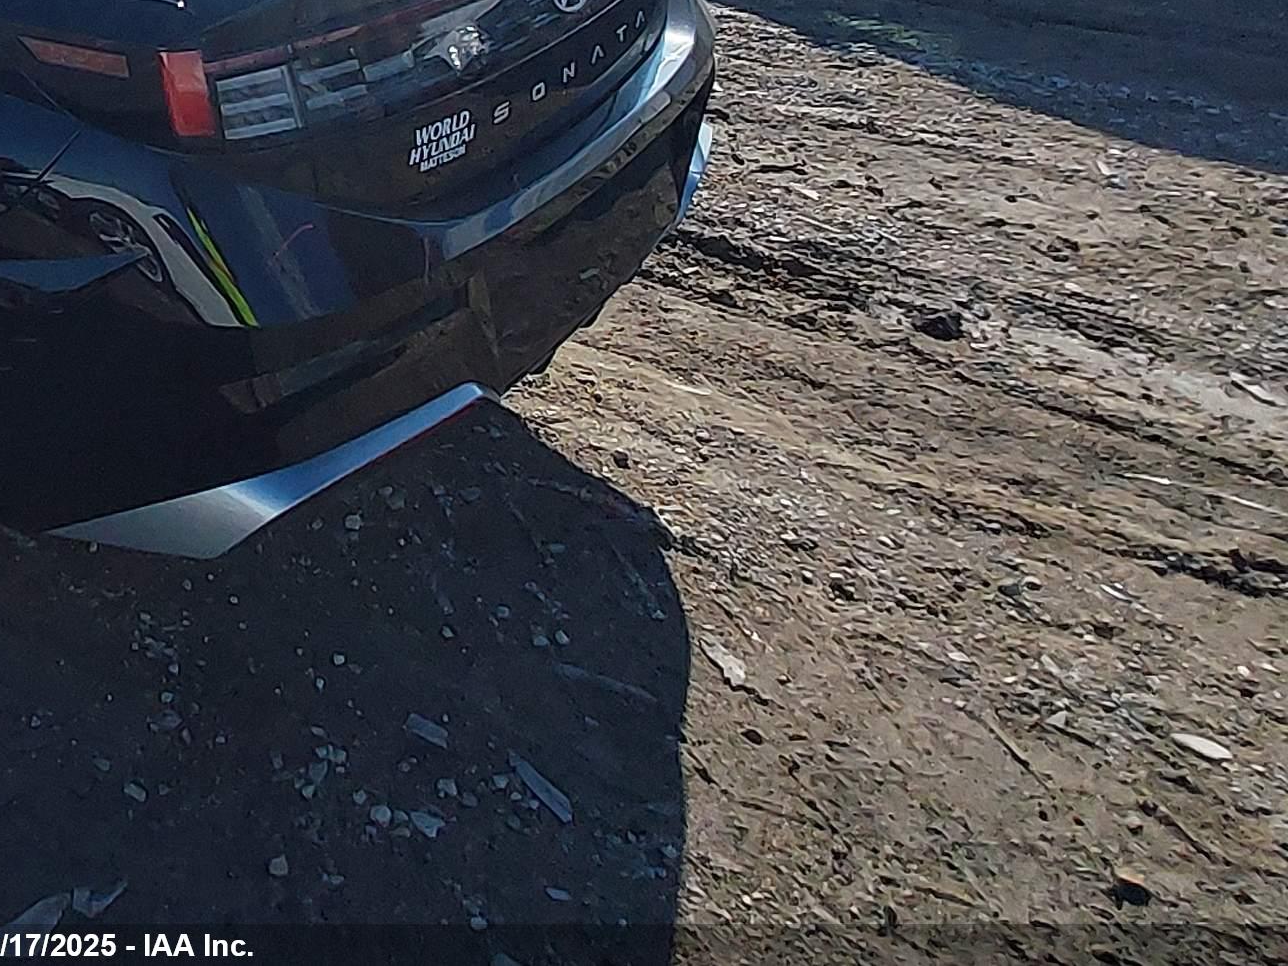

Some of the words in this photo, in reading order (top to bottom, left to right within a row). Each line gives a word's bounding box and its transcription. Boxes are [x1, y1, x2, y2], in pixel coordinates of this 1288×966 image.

[492, 11, 646, 125] SONATA
[409, 123, 476, 165] HYUNDAI
[415, 110, 470, 146] WORLD
